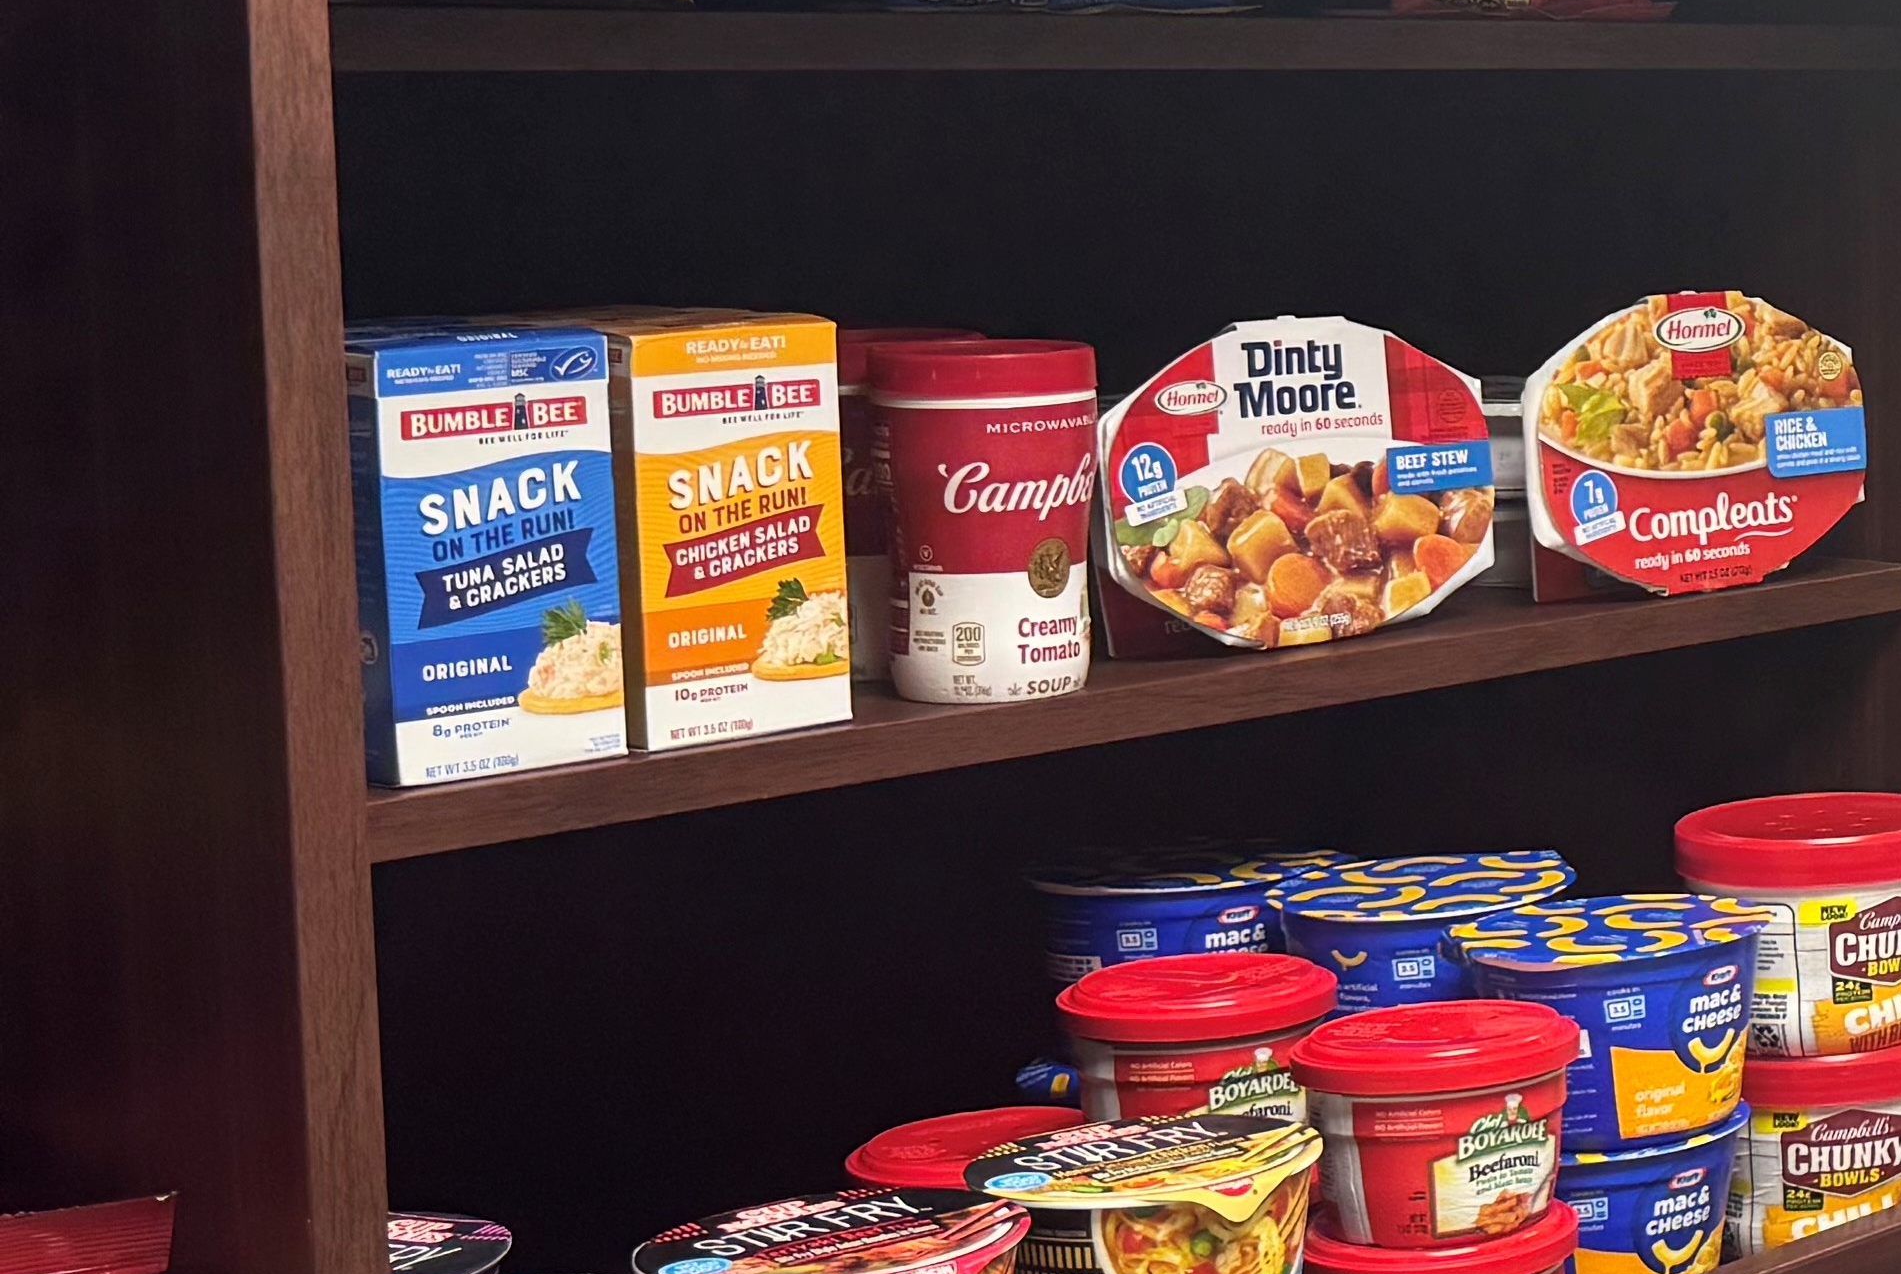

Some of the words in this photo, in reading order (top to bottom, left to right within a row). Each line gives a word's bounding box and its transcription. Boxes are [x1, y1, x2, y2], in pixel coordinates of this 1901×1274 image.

[1667, 317, 1732, 340] Hormel
[387, 367, 426, 380] READY
[1241, 339, 1343, 381] Dinty
[662, 388, 750, 415] BUMBLE
[771, 382, 813, 406] BEE
[1167, 389, 1219, 406] Hormel
[1233, 379, 1356, 419] Moore
[410, 407, 510, 439] BUMBLE
[533, 401, 579, 425] BEE
[1260, 422, 1298, 437] ready
[1301, 420, 1312, 432] in
[1315, 418, 1332, 431] 60
[1334, 412, 1384, 428] seconds
[1775, 418, 1803, 435] RICE
[1805, 416, 1817, 432] &
[1776, 431, 1827, 450] CHICKEN
[1132, 453, 1164, 482] 12g
[1396, 454, 1428, 470] BEEF
[1430, 450, 1469, 467] STEW
[668, 440, 813, 510] SNACK
[420, 460, 581, 536] SNACK
[679, 512, 709, 533] ON
[712, 503, 752, 528] THE
[759, 488, 807, 519] RUN!
[1629, 491, 1794, 545] Compleats
[433, 534, 470, 564] ON
[471, 524, 515, 553] THE
[522, 507, 575, 542] RUN!
[675, 533, 750, 567] CHICKEN
[755, 514, 811, 544] SALAD
[442, 564, 495, 591] TUNA
[501, 543, 564, 574] SALAD
[694, 565, 706, 581] &
[711, 546, 800, 576] CRACKERS
[449, 594, 461, 611] &
[466, 566, 567, 607] CRACKERS
[668, 623, 747, 649] ORIGINAL
[956, 626, 981, 642] 200
[1018, 615, 1078, 639] Creamy
[1017, 640, 1081, 664] Tomato
[422, 656, 512, 682] ORIGINAL
[1027, 676, 1072, 695] SOUP
[432, 724, 451, 738] 8g
[454, 719, 510, 734] PROTEIN
[1690, 990, 1726, 1013] mac
[1729, 982, 1741, 1002] &
[1458, 1118, 1547, 1156] BOYARDEE
[1810, 1116, 1892, 1142] Campbell's
[1819, 1167, 1881, 1187] BOWLS
